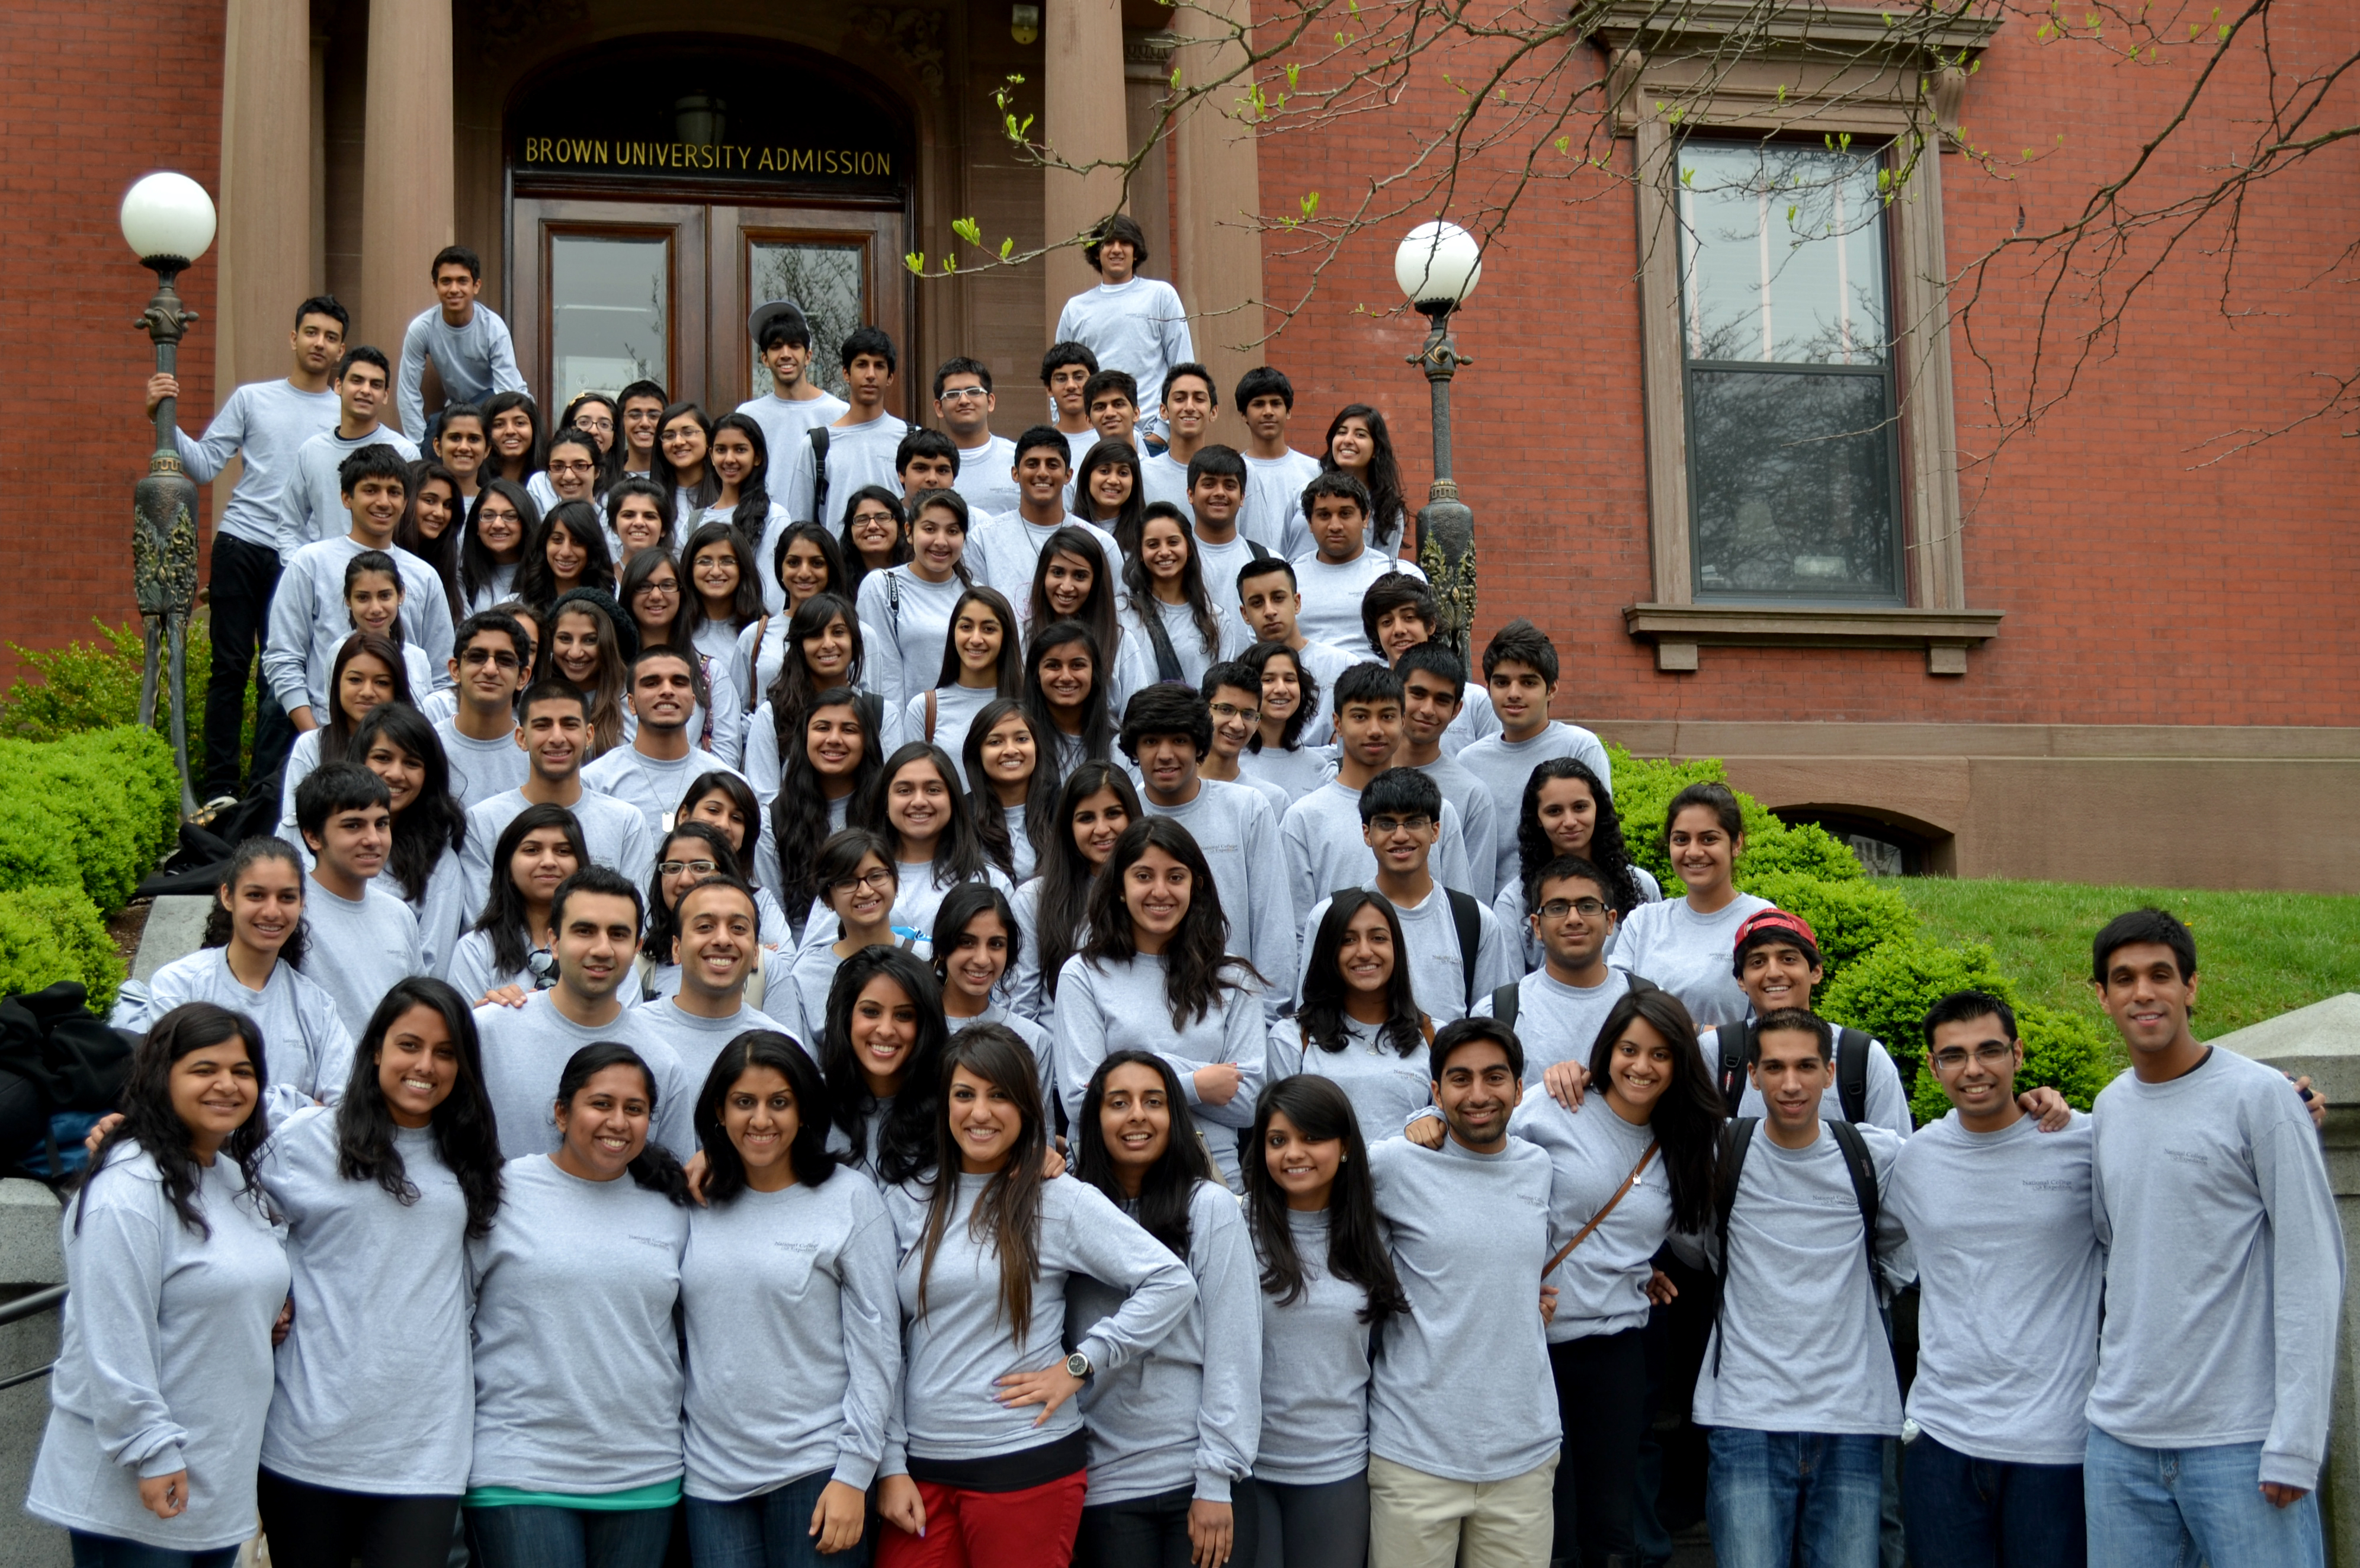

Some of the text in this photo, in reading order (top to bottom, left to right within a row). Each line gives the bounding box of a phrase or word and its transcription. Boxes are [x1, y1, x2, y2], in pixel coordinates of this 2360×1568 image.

[526, 137, 890, 175] BROWN UNIVERSITY ADMISSION
[2186, 1151, 2208, 1160] College
